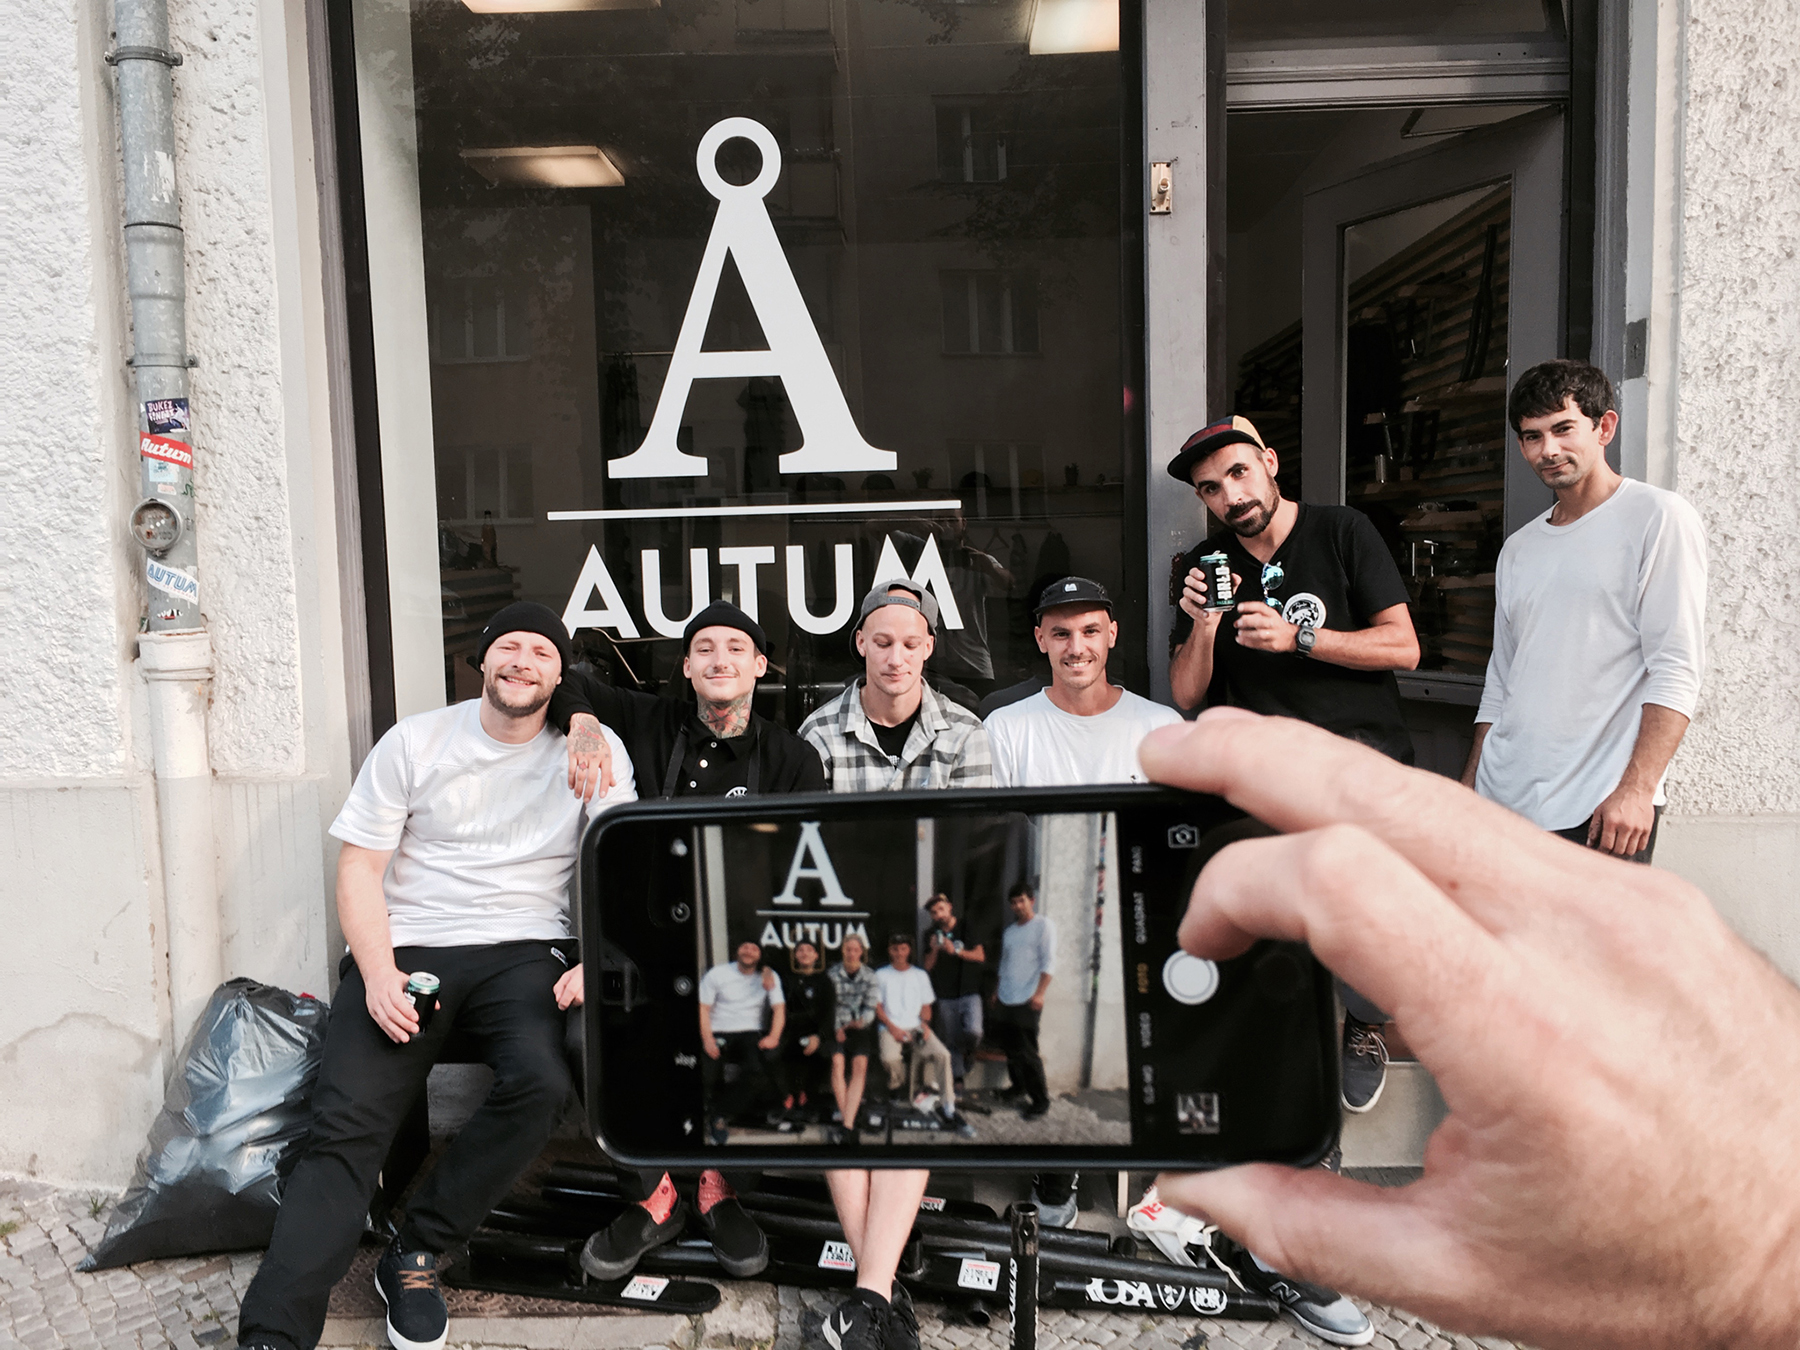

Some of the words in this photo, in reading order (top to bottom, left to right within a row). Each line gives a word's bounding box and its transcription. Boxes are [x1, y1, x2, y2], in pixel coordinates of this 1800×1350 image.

[141, 438, 191, 465] Autum
[147, 563, 197, 598] AUTUM
[561, 532, 964, 640] AUTUM
[1131, 845, 1143, 874] PANO
[1133, 891, 1147, 945] QUADRAT
[760, 921, 870, 949] AUTUM
[1137, 962, 1149, 994] FOTO
[1140, 1012, 1152, 1048] VIDEO
